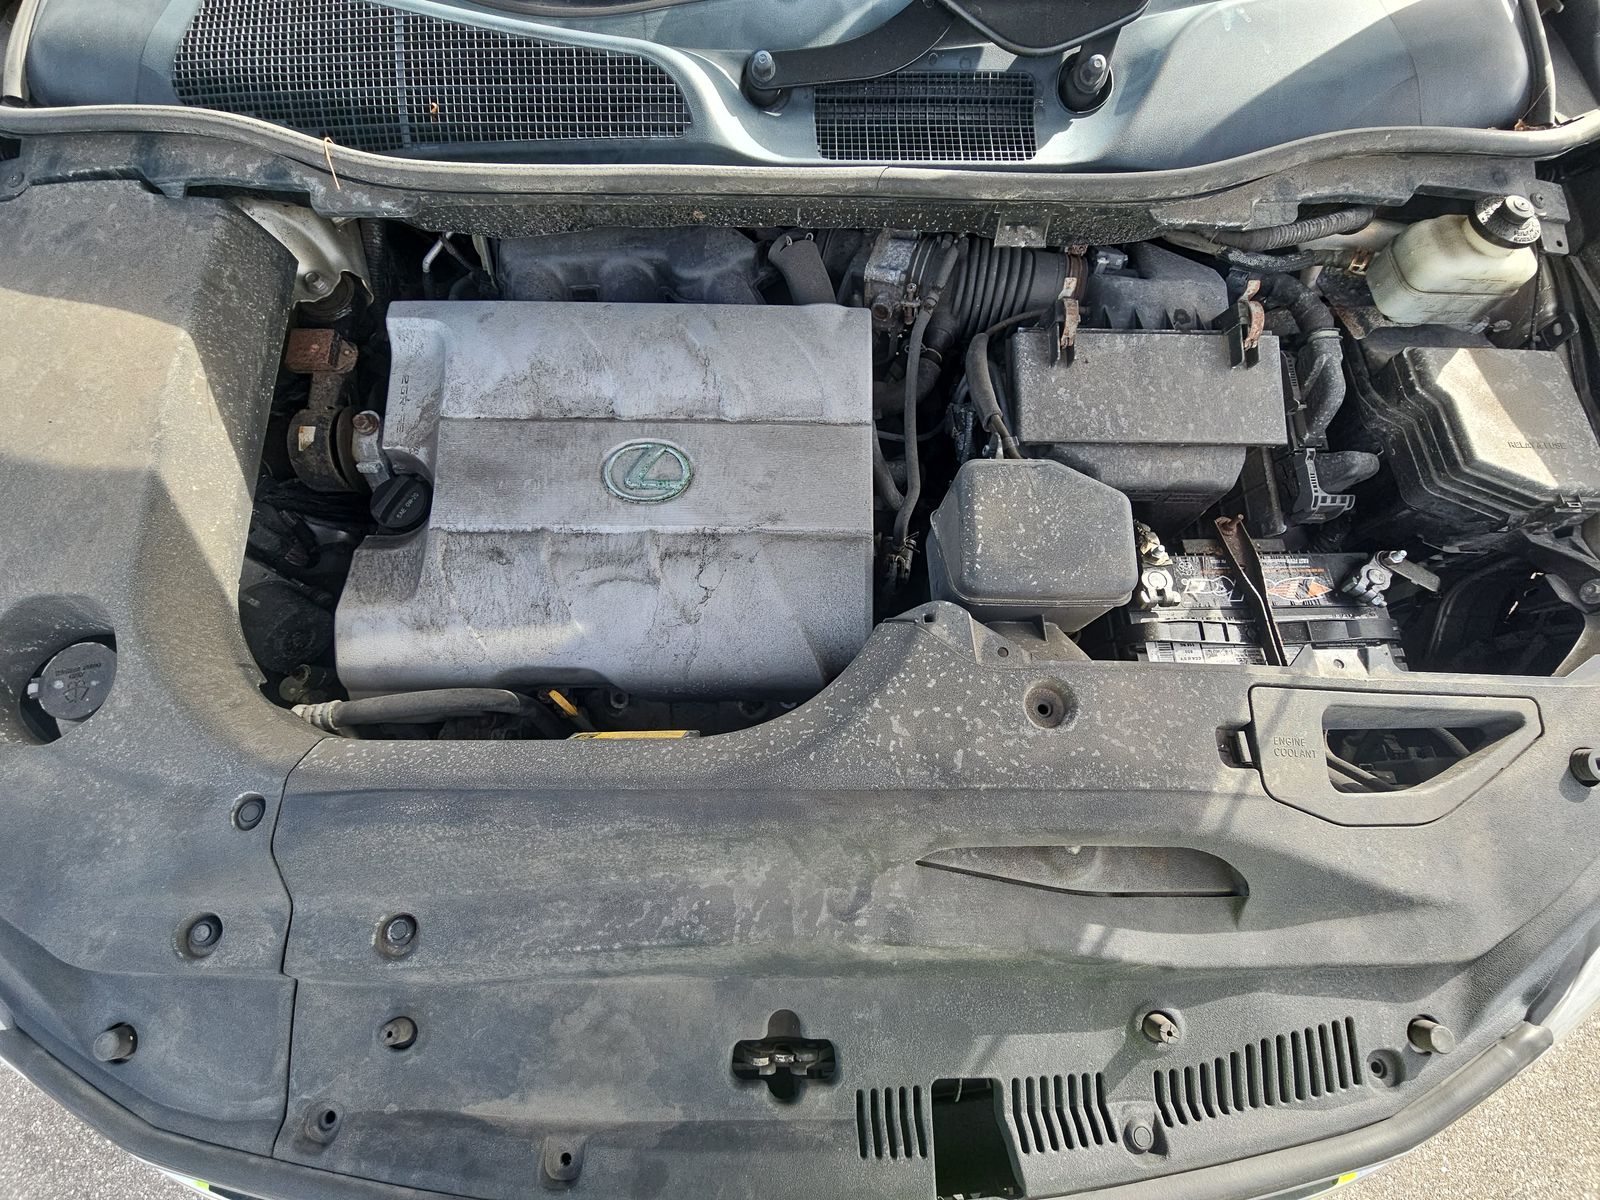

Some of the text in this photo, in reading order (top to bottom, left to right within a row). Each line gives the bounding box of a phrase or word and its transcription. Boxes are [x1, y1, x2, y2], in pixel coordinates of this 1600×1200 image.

[1508, 441, 1535, 449] RELAY
[1273, 737, 1306, 747] ENGINE
[1273, 748, 1317, 758] COOLANT
